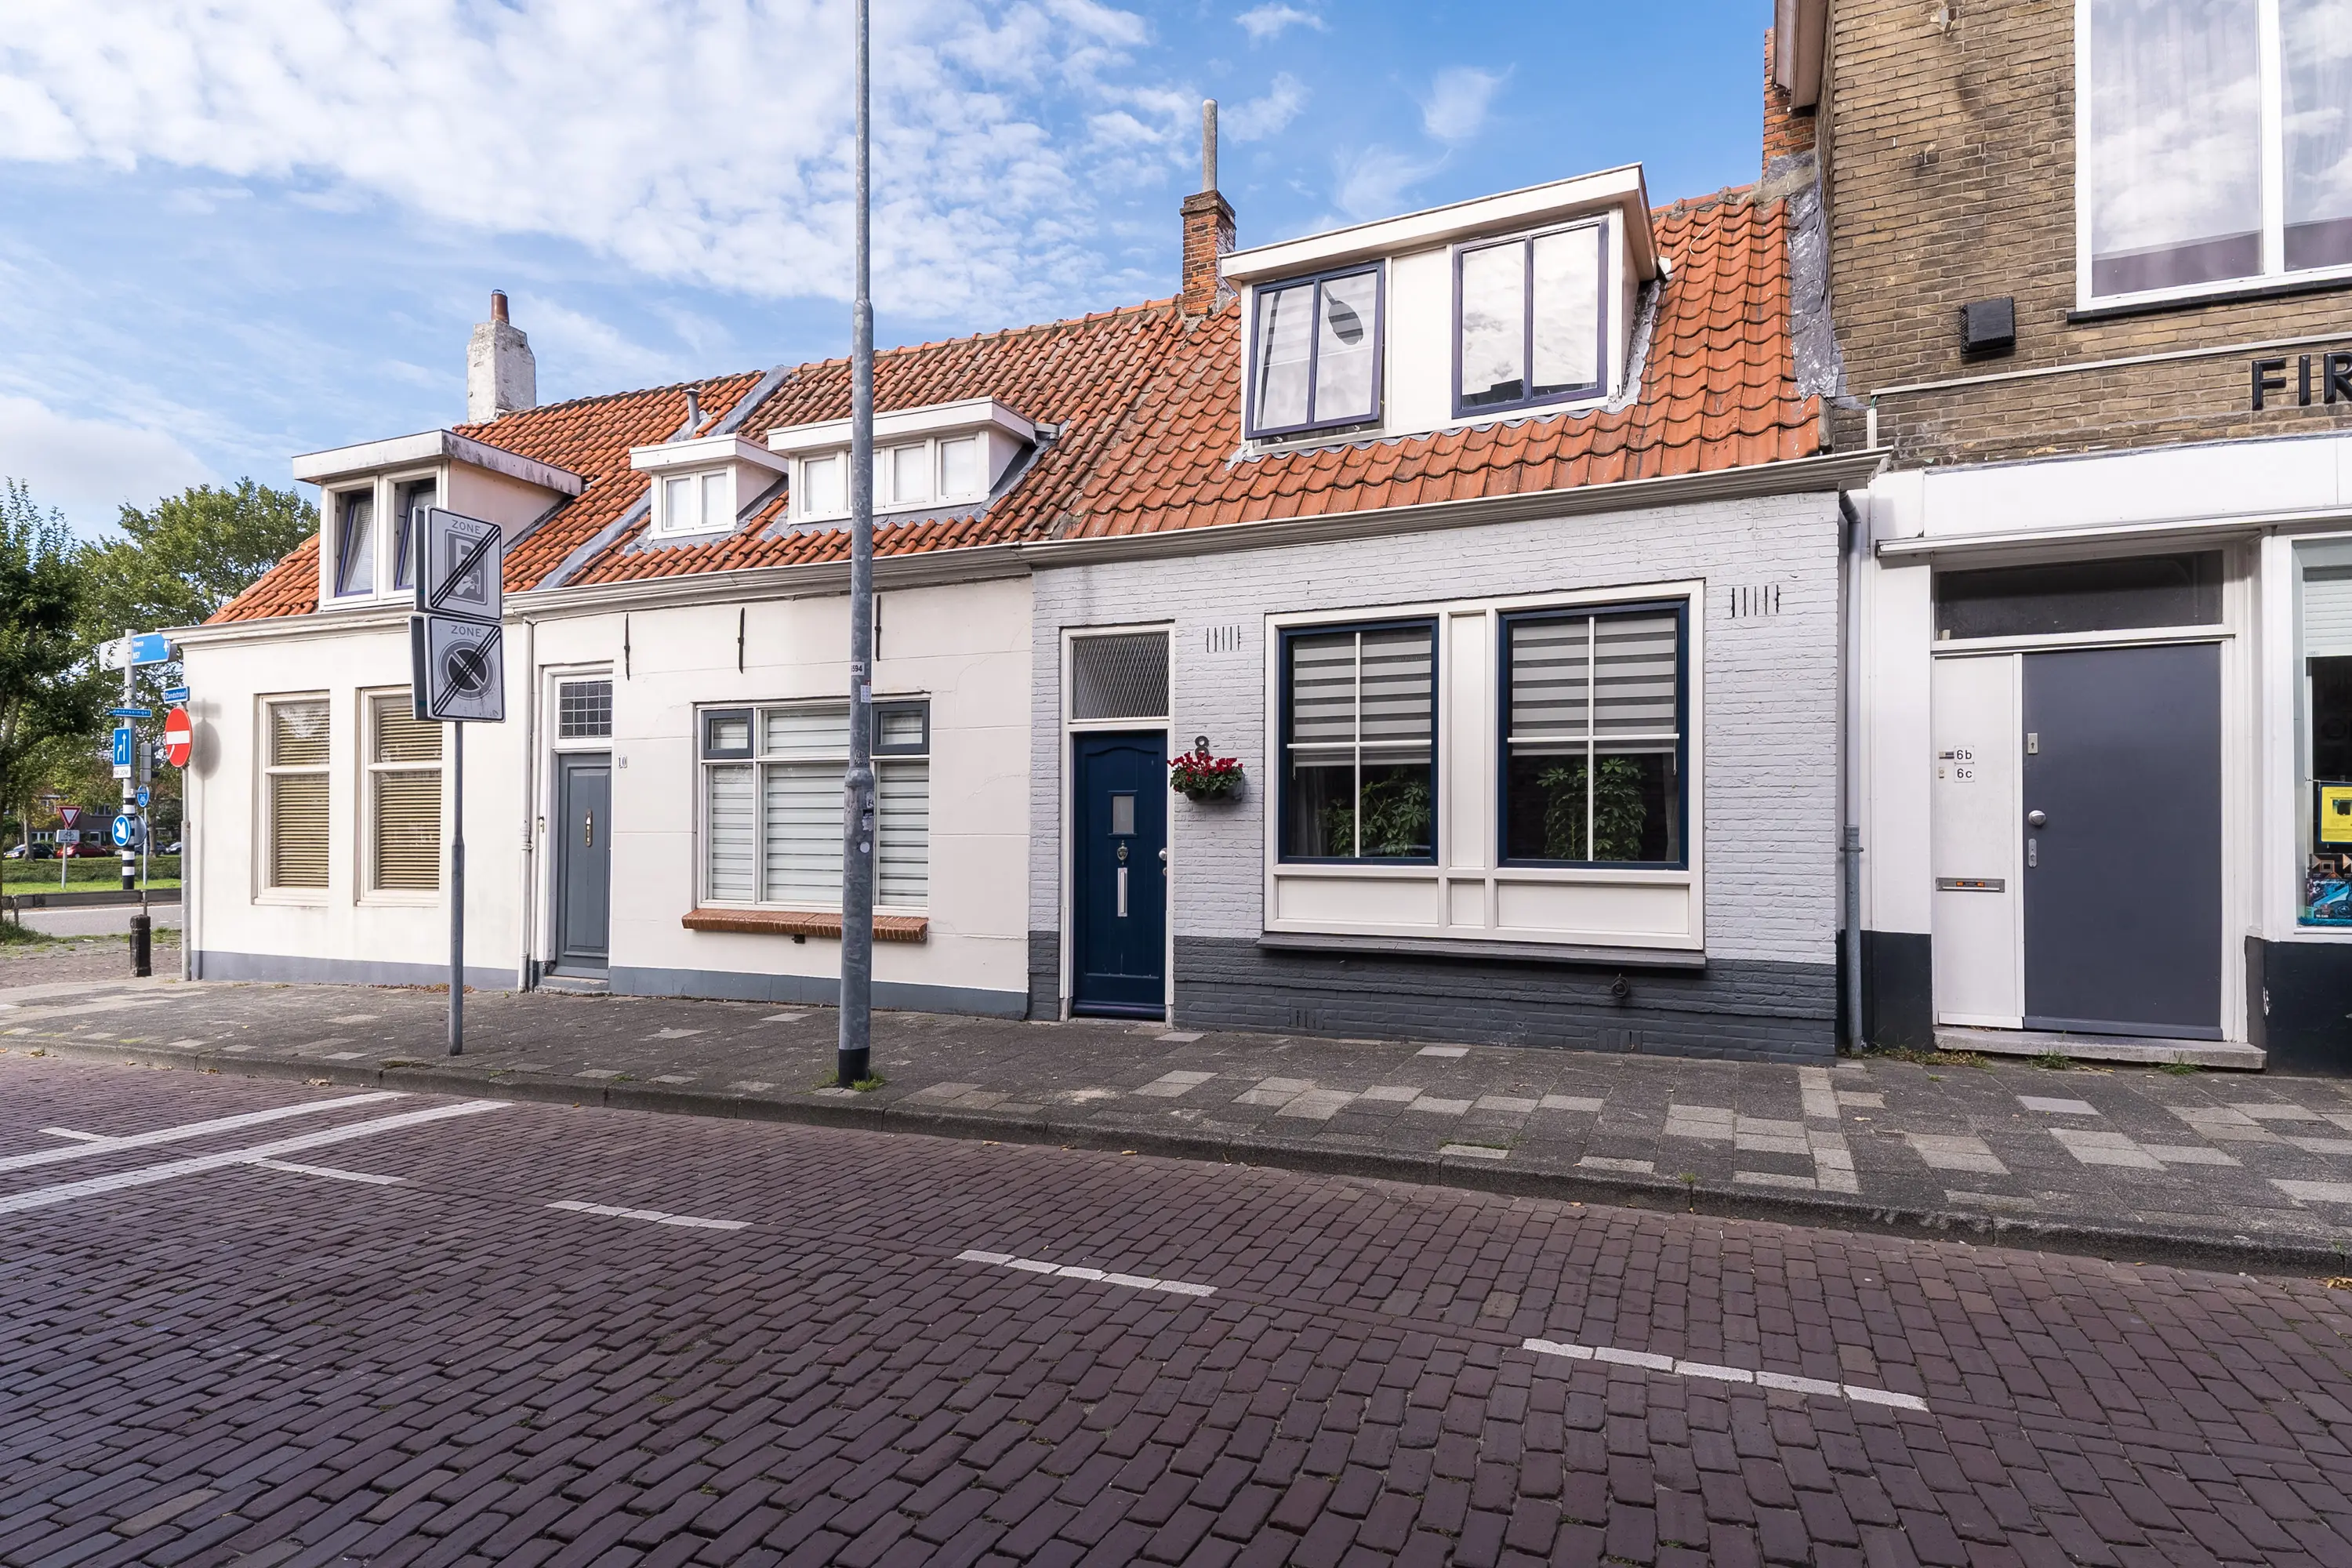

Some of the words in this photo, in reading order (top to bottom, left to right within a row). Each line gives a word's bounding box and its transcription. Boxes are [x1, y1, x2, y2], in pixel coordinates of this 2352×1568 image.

[452, 520, 481, 535] ZONE
[451, 625, 481, 637] ZONE
[165, 690, 187, 700] Zandstraat
[1195, 735, 1210, 759] 8
[1956, 750, 1973, 760] 6b
[618, 755, 628, 768] 10
[1957, 769, 1973, 778] 6c
